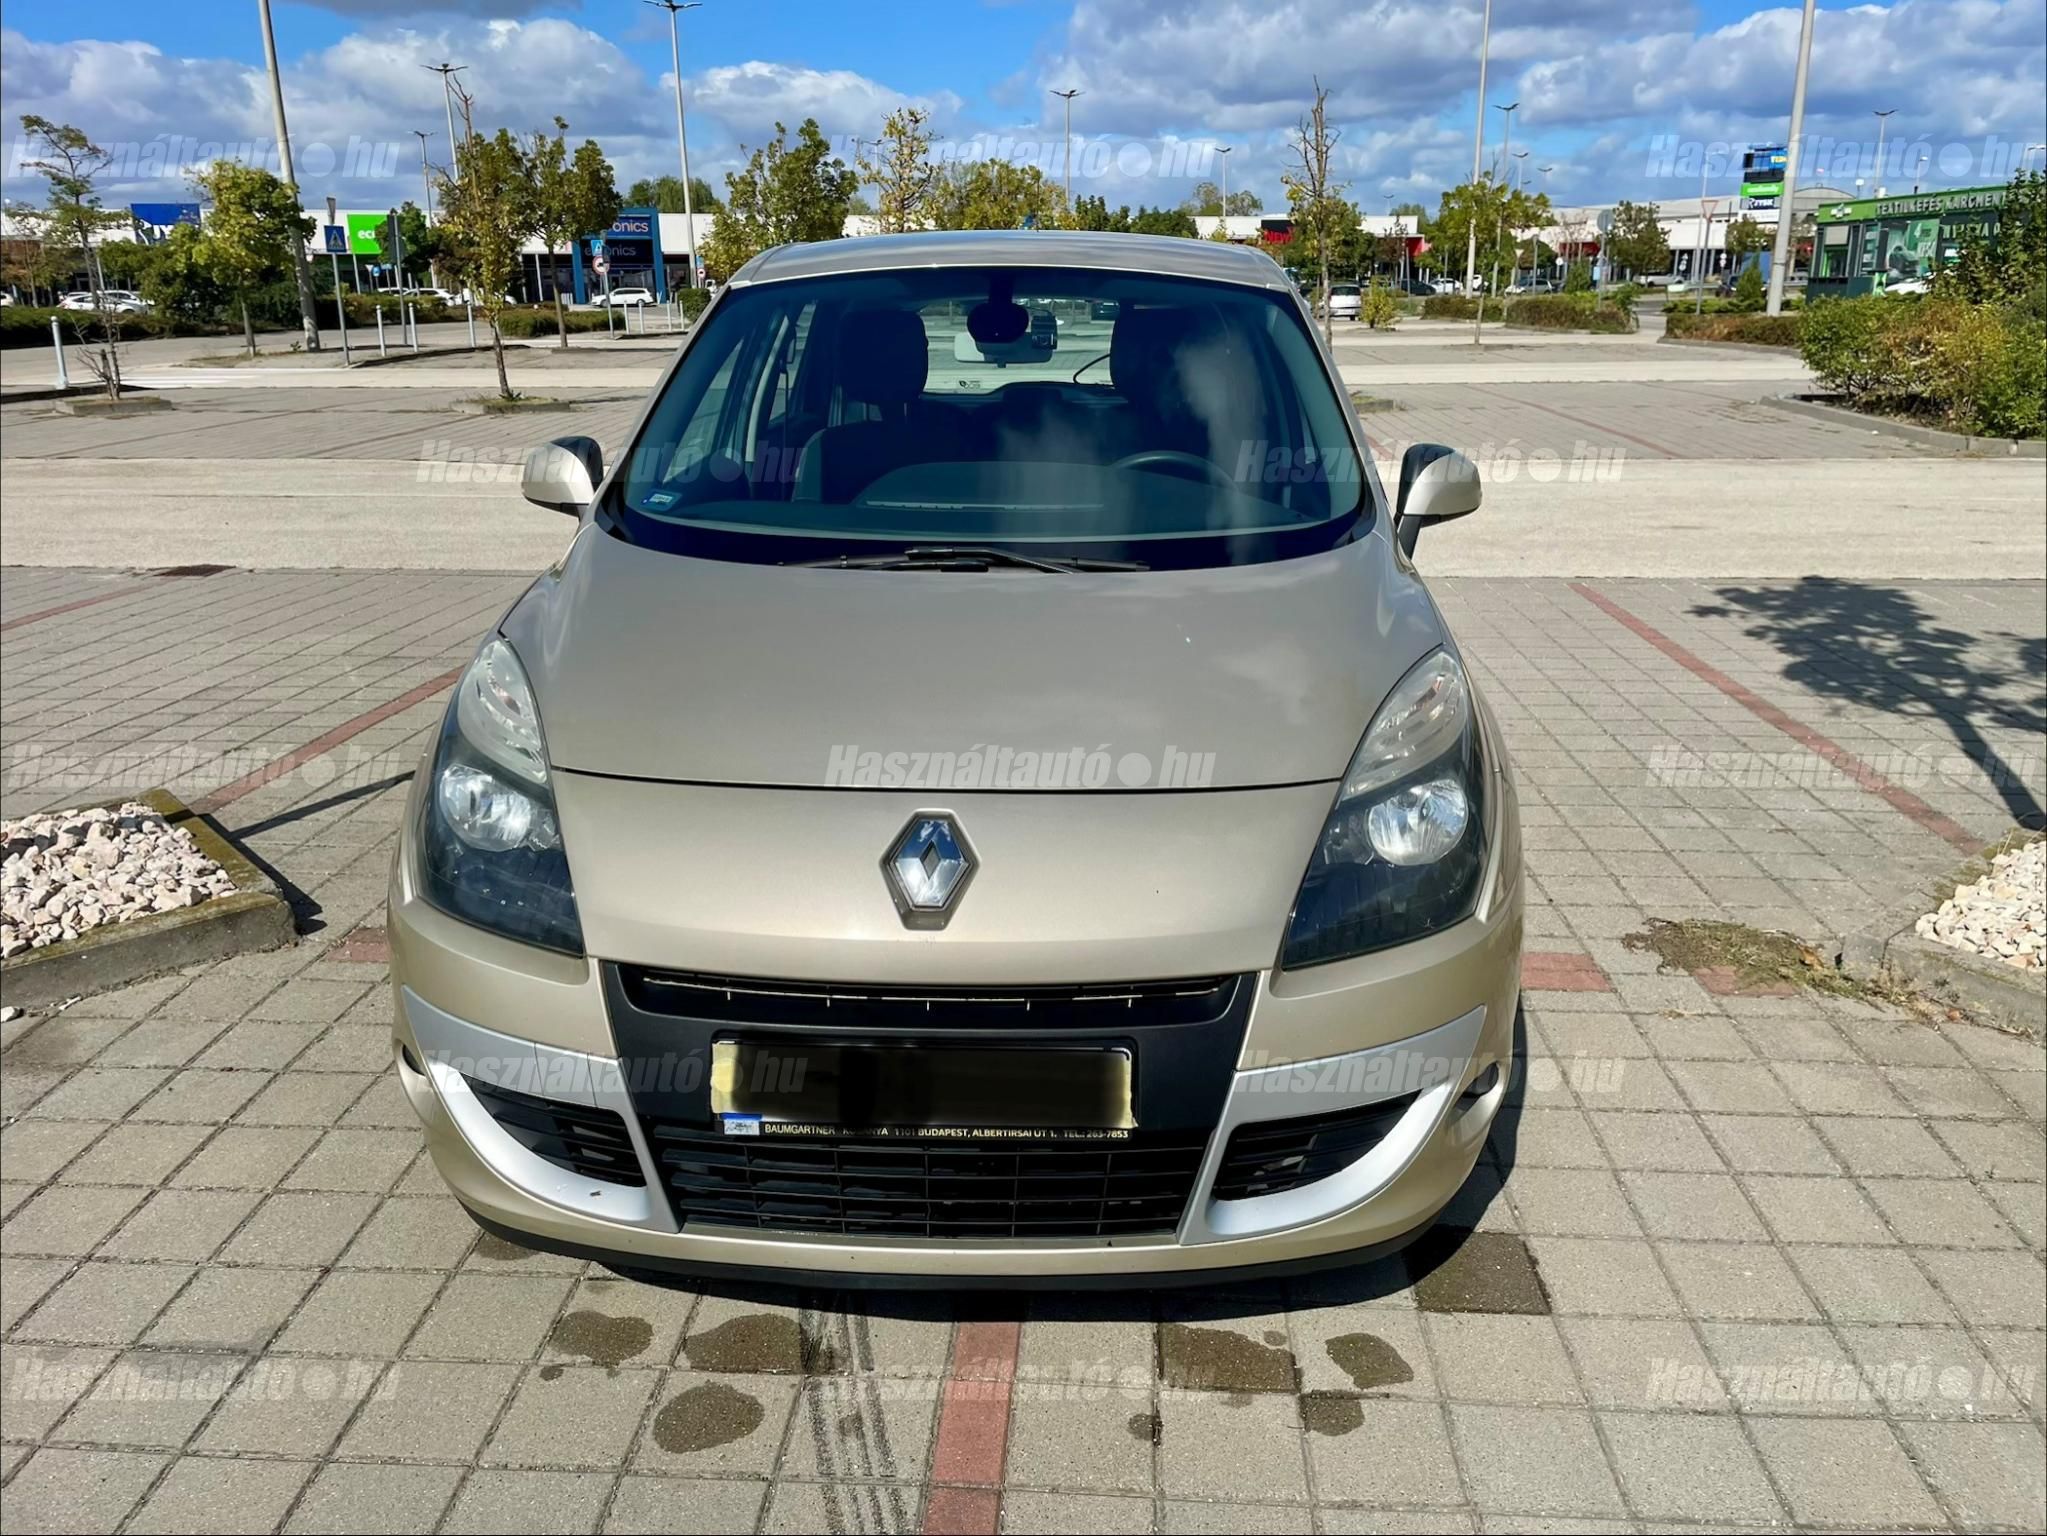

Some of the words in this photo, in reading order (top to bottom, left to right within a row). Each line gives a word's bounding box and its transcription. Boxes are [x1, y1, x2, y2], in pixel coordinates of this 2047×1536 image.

[764, 1123, 836, 1136] BAUMGARTNER
[918, 1128, 971, 1139] BUDAPEST,
[972, 1128, 1032, 1138] ALBERTIRSAI
